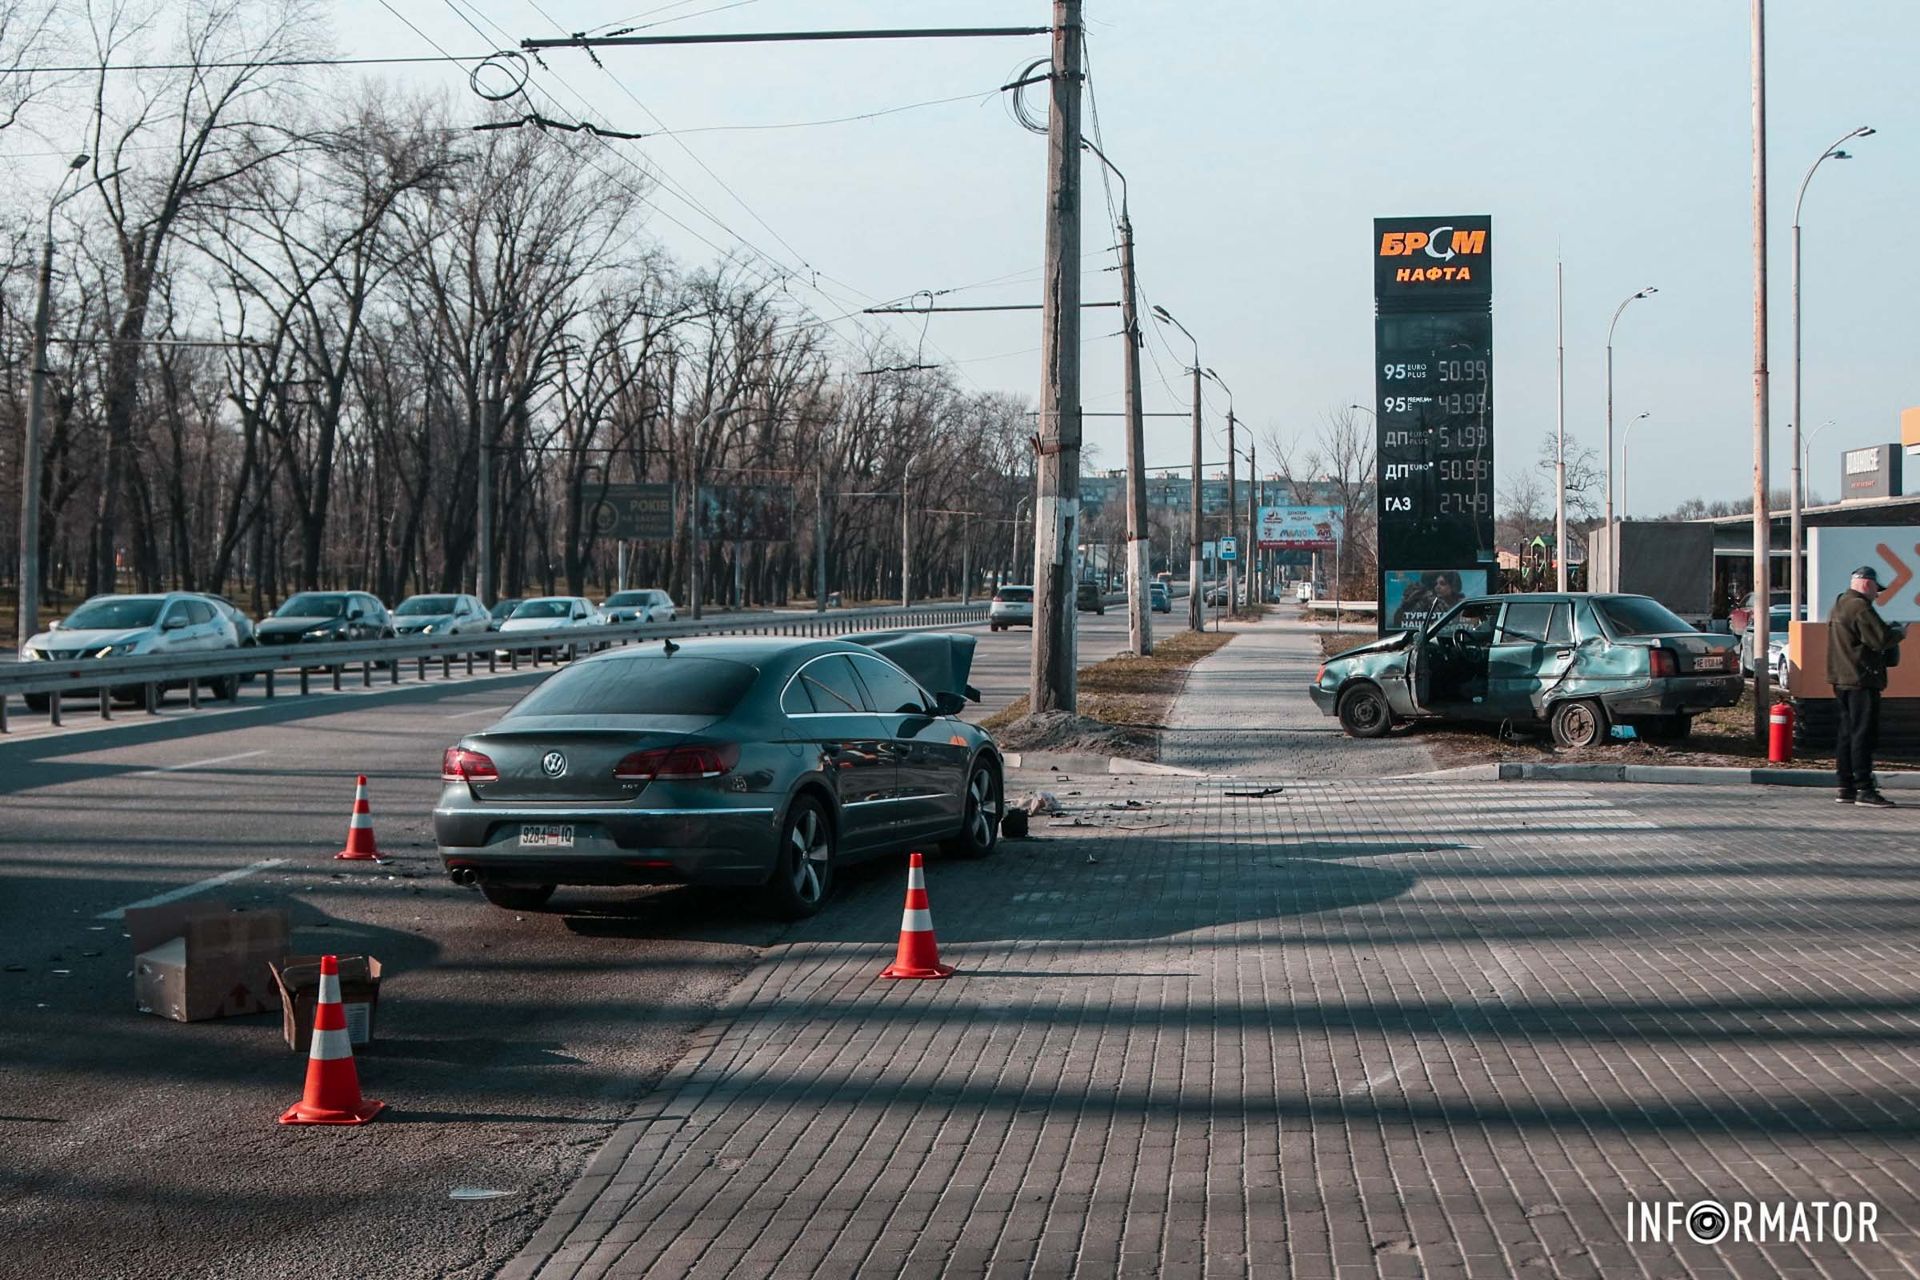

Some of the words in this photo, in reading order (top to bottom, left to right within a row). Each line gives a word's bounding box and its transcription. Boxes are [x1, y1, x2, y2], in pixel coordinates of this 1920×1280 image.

[1396, 267, 1471, 282] НАФТА
[1384, 364, 1406, 380] 95
[1438, 361, 1487, 381] 50.99
[1384, 397, 1406, 413] 95
[1438, 394, 1487, 414] 43.99
[1384, 431, 1408, 448] ДП
[1439, 427, 1487, 448] 51.99
[1385, 464, 1409, 480] ДП
[1409, 463, 1429, 471] EURO
[1385, 496, 1411, 511] ГАЗ
[523, 827, 546, 844] 9284
